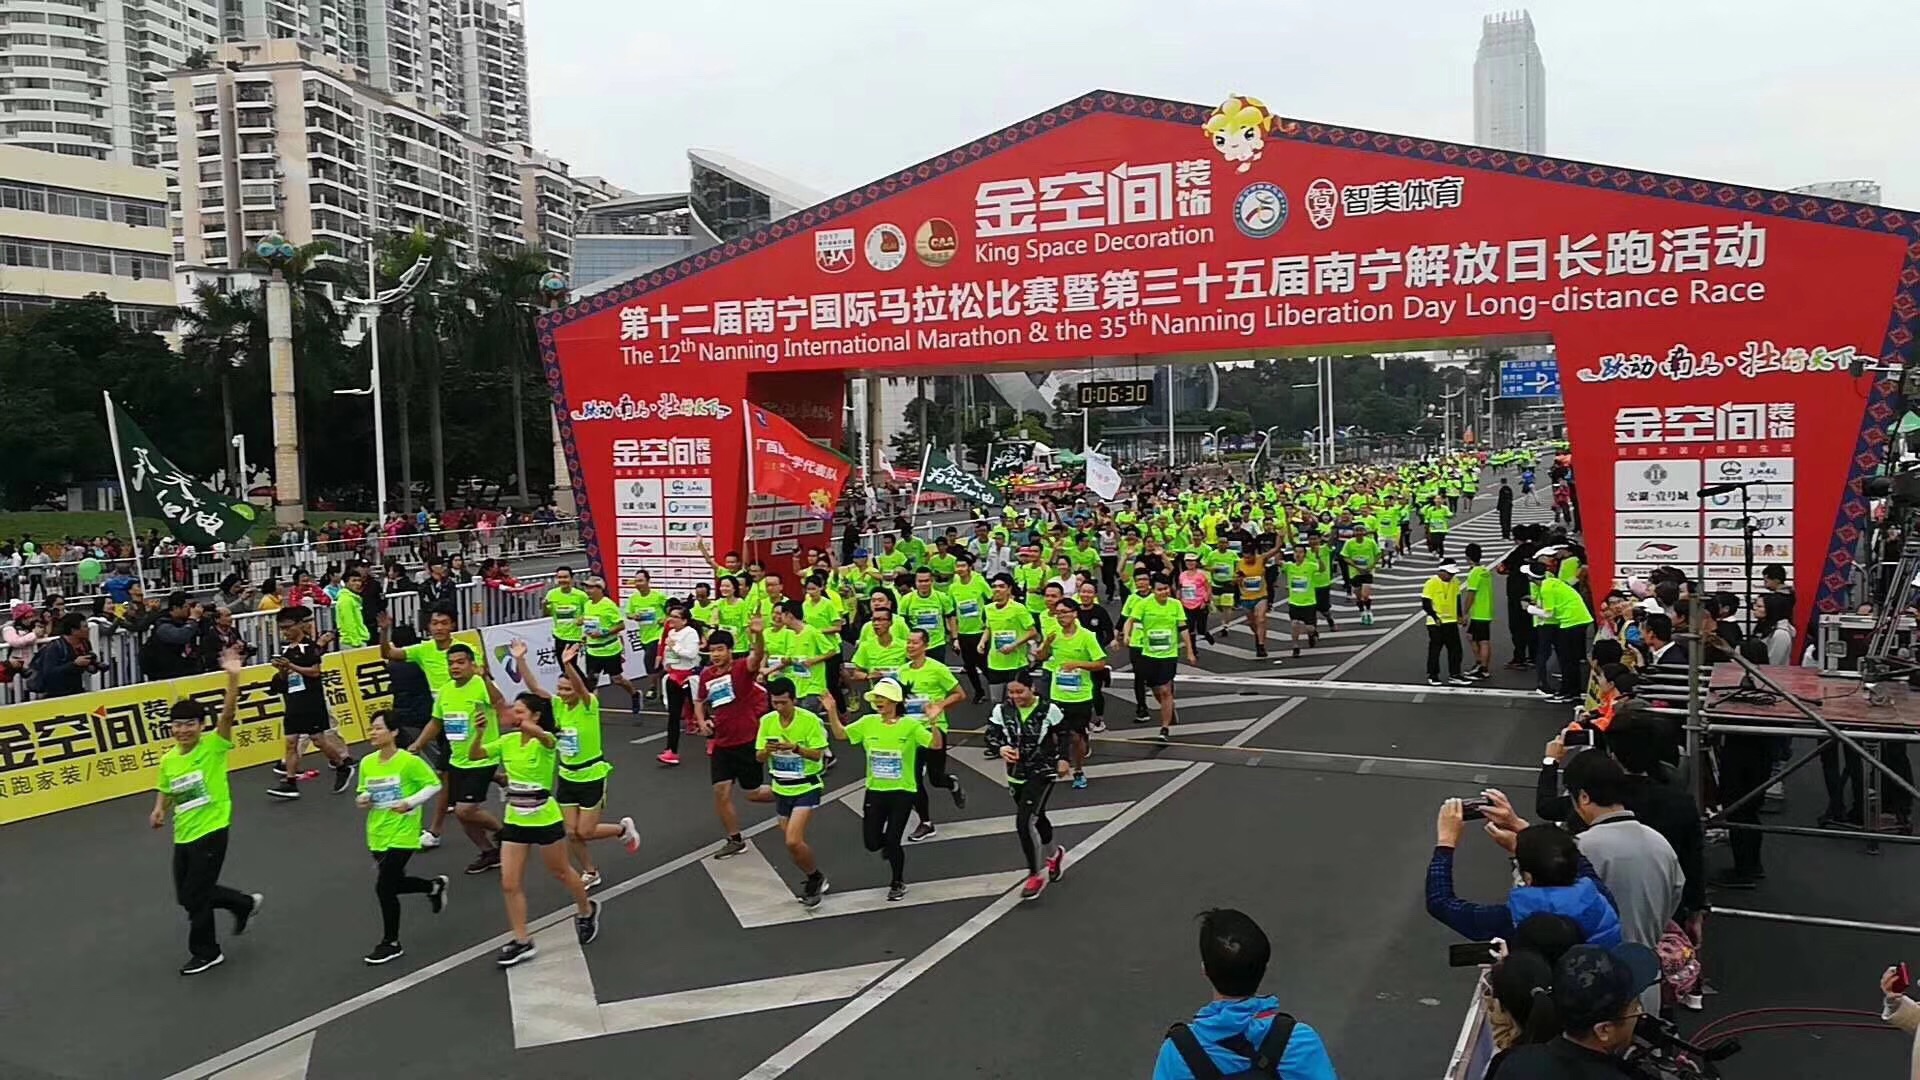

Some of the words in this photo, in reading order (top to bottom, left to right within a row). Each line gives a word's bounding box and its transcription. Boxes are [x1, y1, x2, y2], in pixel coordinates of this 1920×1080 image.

[1175, 158, 1212, 217] 装饰
[1343, 177, 1464, 216] 智美体育
[975, 241, 1019, 266] King
[1025, 238, 1088, 262] Space
[1095, 224, 1214, 254] Decoration
[619, 221, 1767, 341] 第十二届南宁国际马拉松比赛暨第三十五届南宁解放日长跑活动
[620, 346, 654, 365] The
[659, 337, 696, 364] 12th
[699, 340, 779, 364] Nanning
[784, 329, 910, 358] International
[917, 324, 1021, 350] Marathon
[1028, 321, 1049, 343] &
[1056, 319, 1092, 341] the
[1100, 308, 1148, 339] 35th
[1151, 309, 1255, 336] Nanning
[1264, 299, 1393, 328] Liberation
[1404, 296, 1456, 324] Day
[1466, 286, 1679, 321] Long-distance
[1690, 279, 1766, 305] Race
[1081, 384, 1148, 404] 0:06:30
